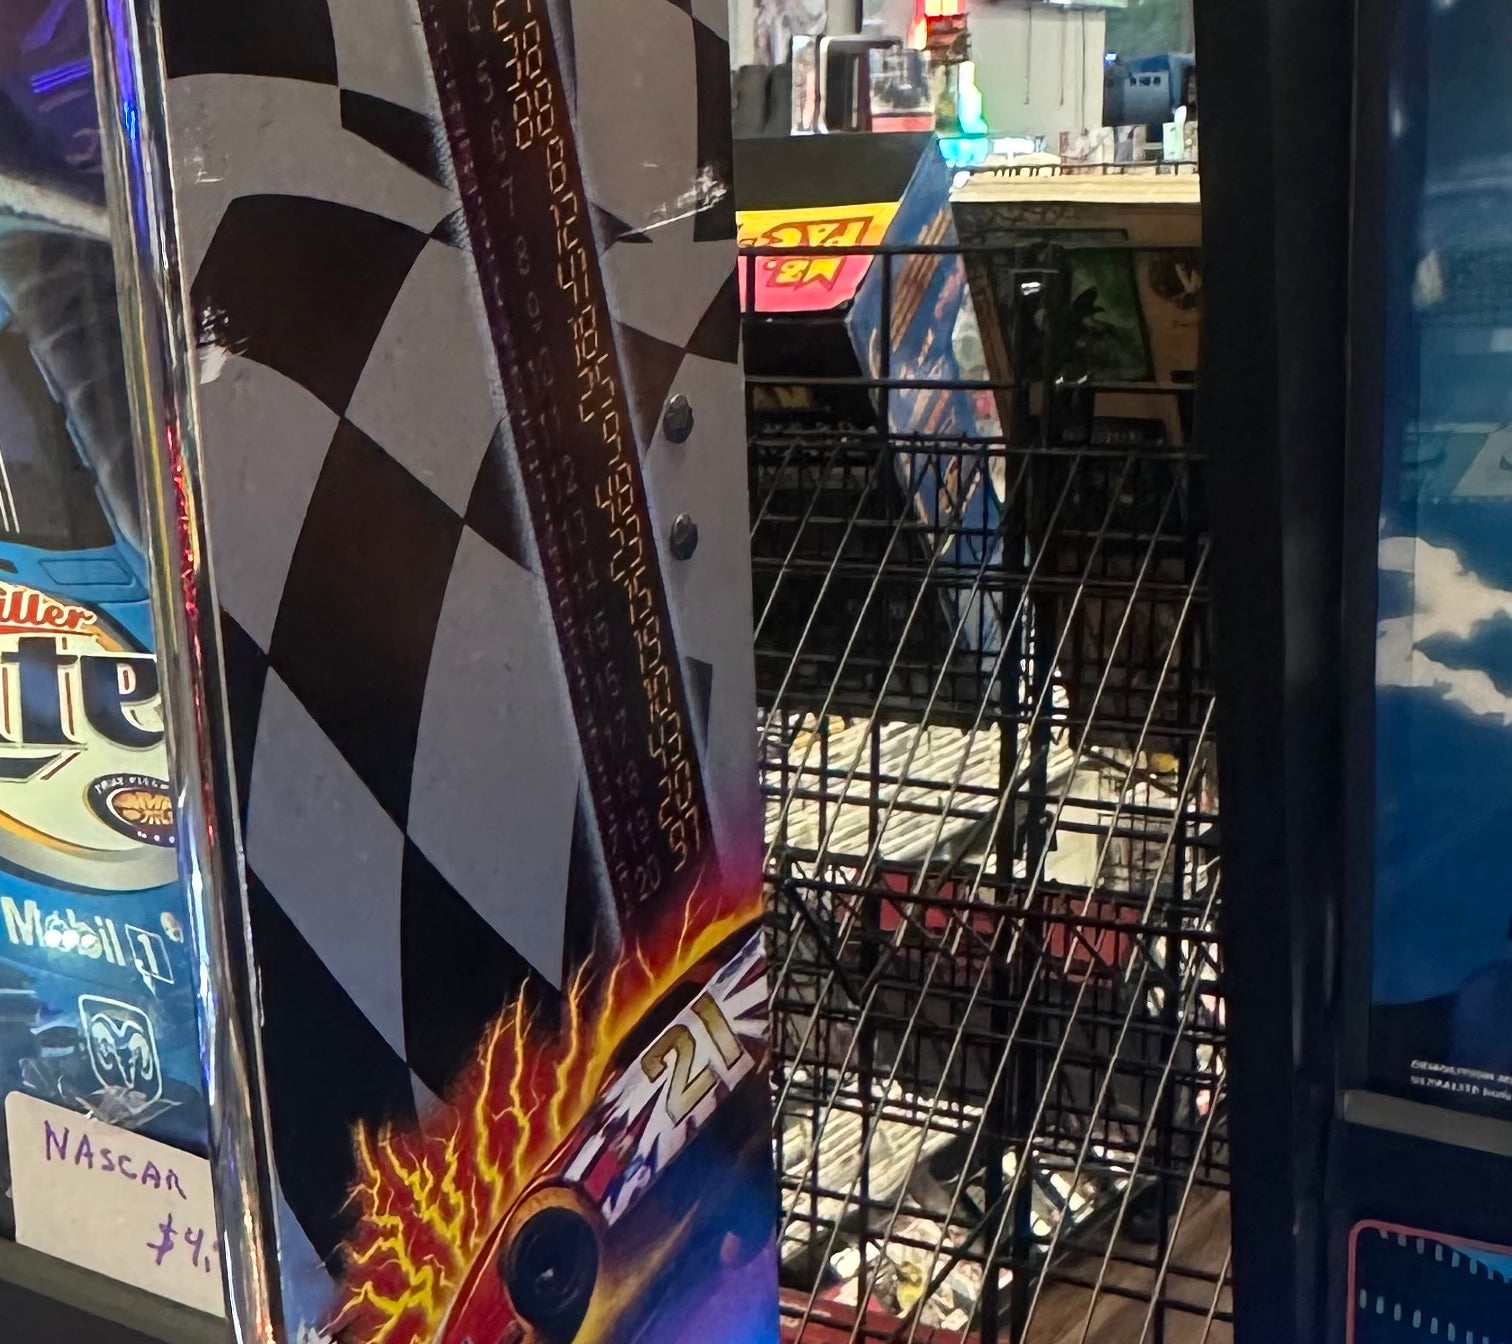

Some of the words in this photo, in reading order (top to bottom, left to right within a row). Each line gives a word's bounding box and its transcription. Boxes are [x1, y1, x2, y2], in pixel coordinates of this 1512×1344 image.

[502, 20, 543, 92] 38
[513, 77, 555, 151] 88
[546, 135, 567, 195] 8
[549, 191, 579, 255] 12
[567, 304, 599, 367] 18
[577, 352, 615, 423] 25
[602, 410, 622, 466] 9
[595, 462, 634, 523] 48
[609, 514, 643, 582] 22
[623, 565, 652, 625] 15
[633, 616, 661, 673] 19
[649, 711, 682, 766] 43
[658, 760, 696, 829] 20
[663, 806, 699, 872] 97
[0, 896, 127, 968] Mobil
[638, 993, 746, 1129] 21
[43, 1120, 187, 1200] NASCAR
